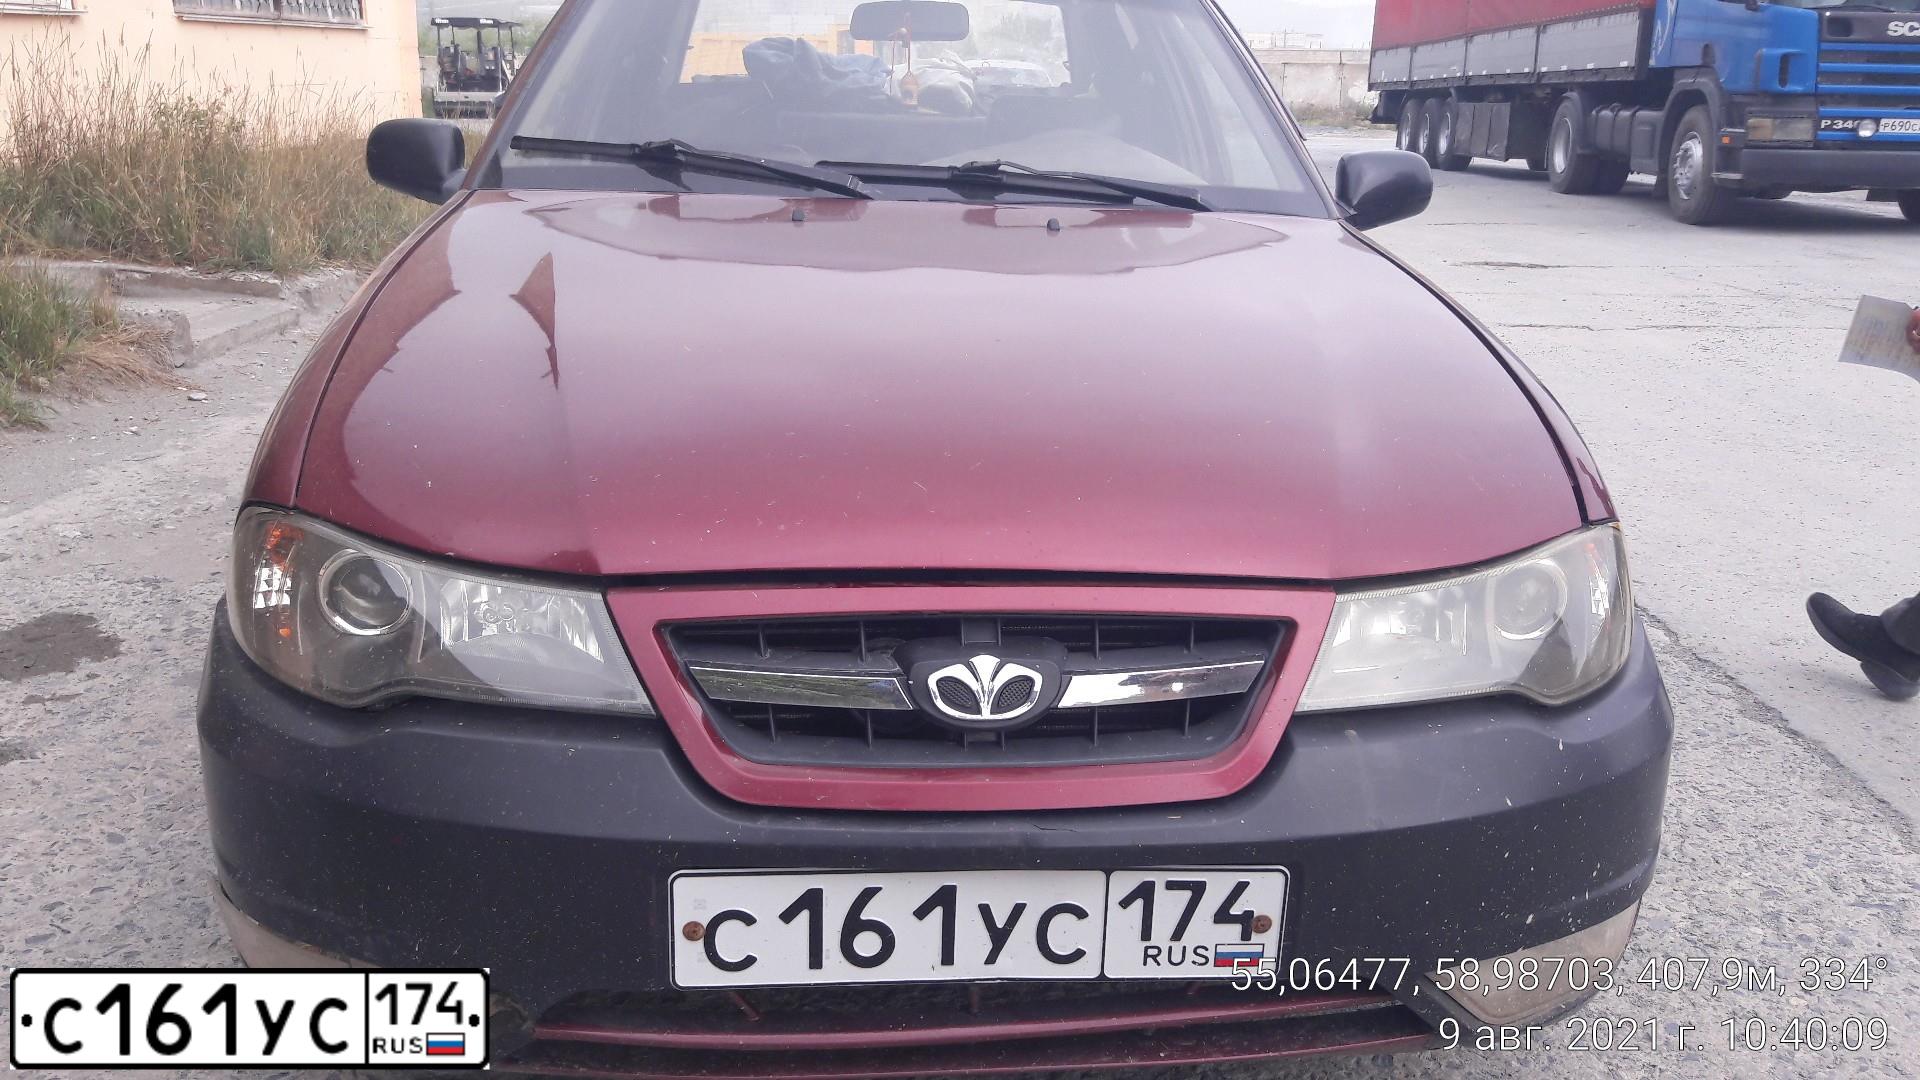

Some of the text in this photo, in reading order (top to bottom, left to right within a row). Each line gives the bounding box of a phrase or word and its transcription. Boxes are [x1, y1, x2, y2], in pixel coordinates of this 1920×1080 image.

[1887, 21, 1920, 36] SC
[1117, 880, 1255, 942] 174
[1143, 944, 1210, 967] RUS
